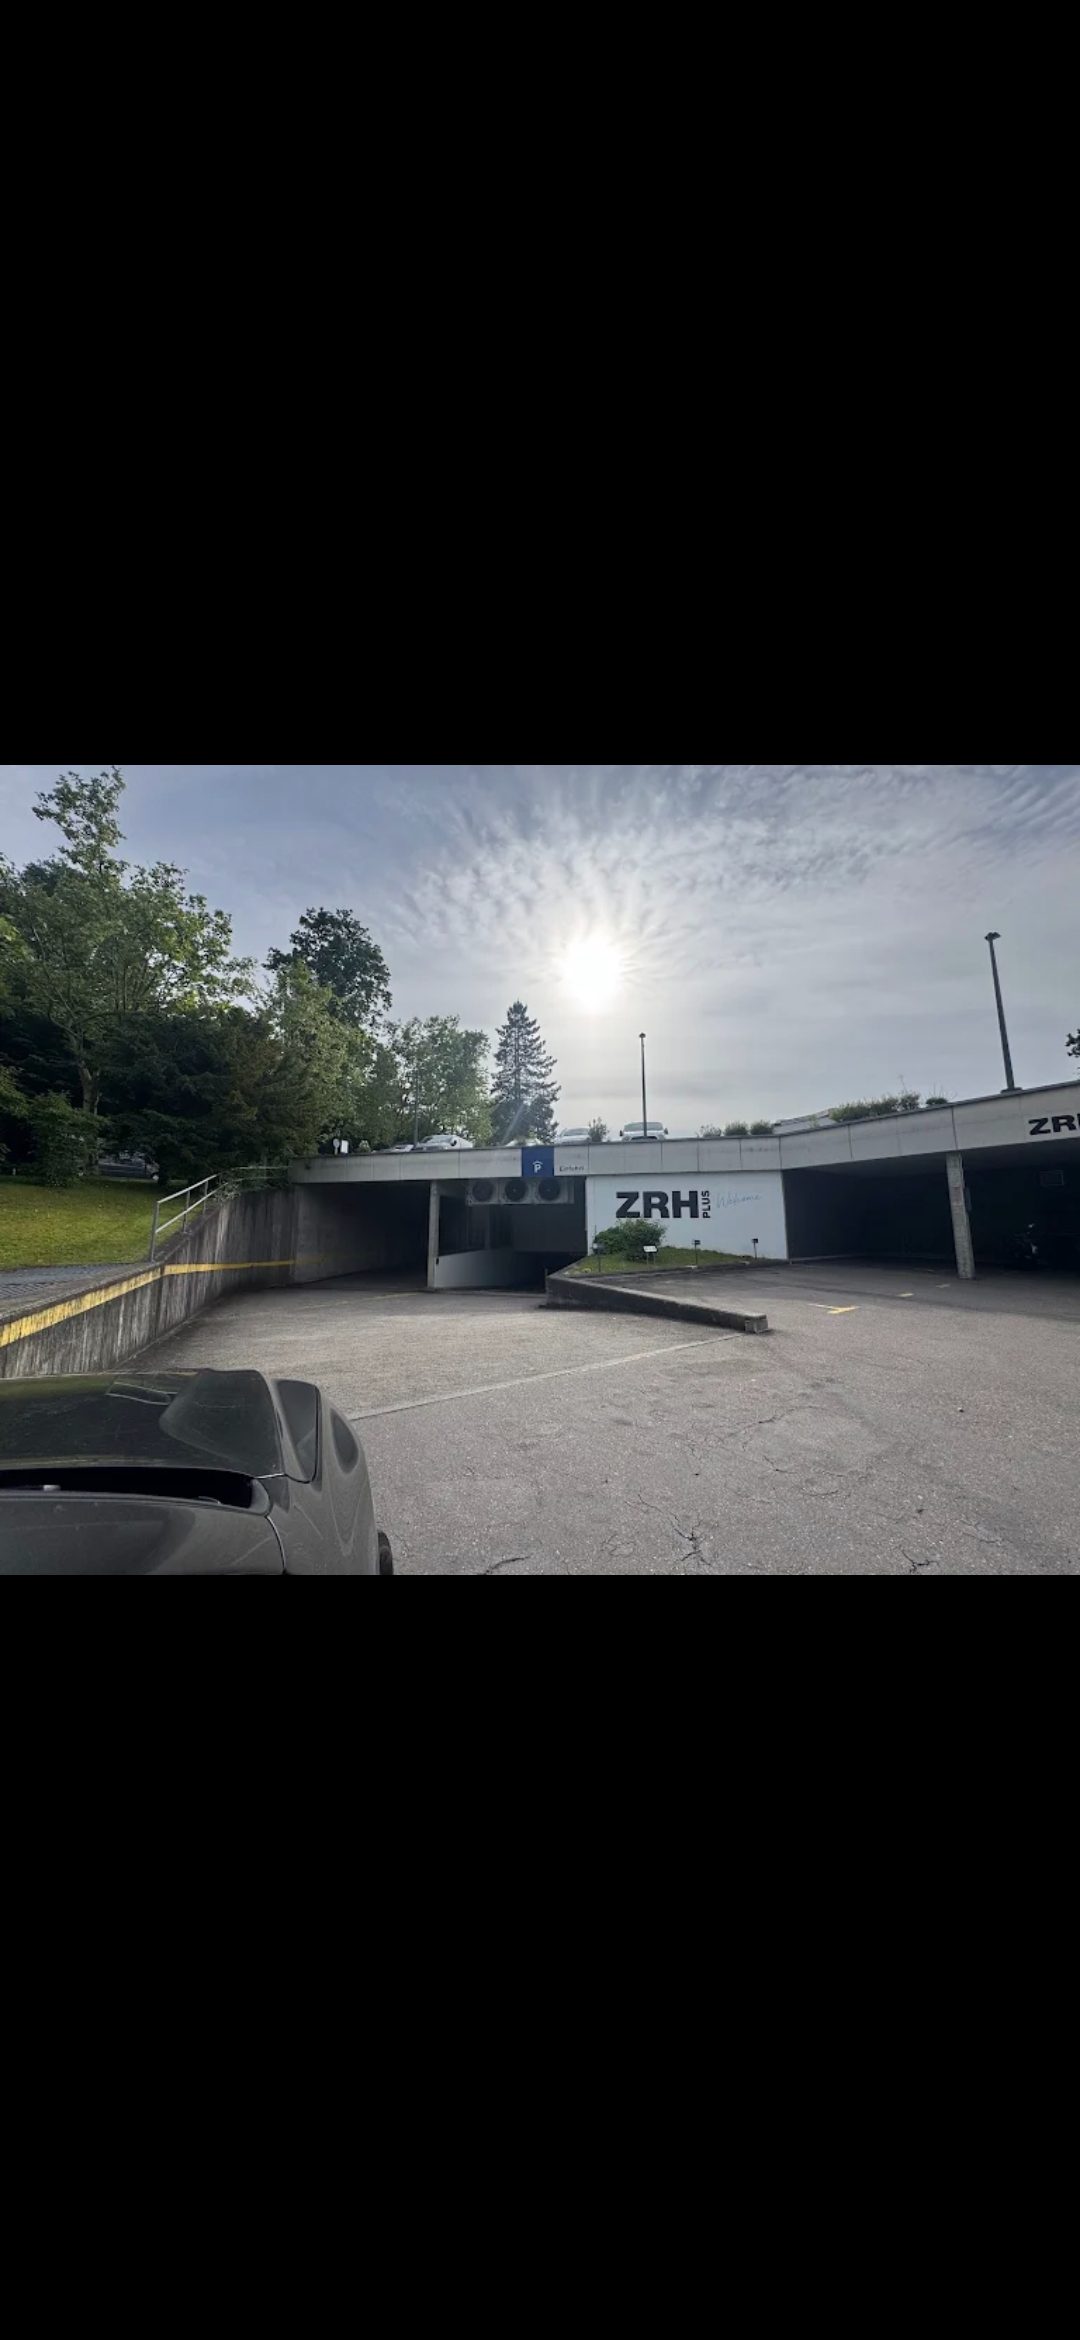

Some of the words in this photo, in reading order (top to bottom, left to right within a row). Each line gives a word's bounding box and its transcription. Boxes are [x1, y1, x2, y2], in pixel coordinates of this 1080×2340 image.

[1028, 1113, 1080, 1135] ZR
[616, 1190, 699, 1218] ZRH
[701, 1190, 711, 1219] PLUS
